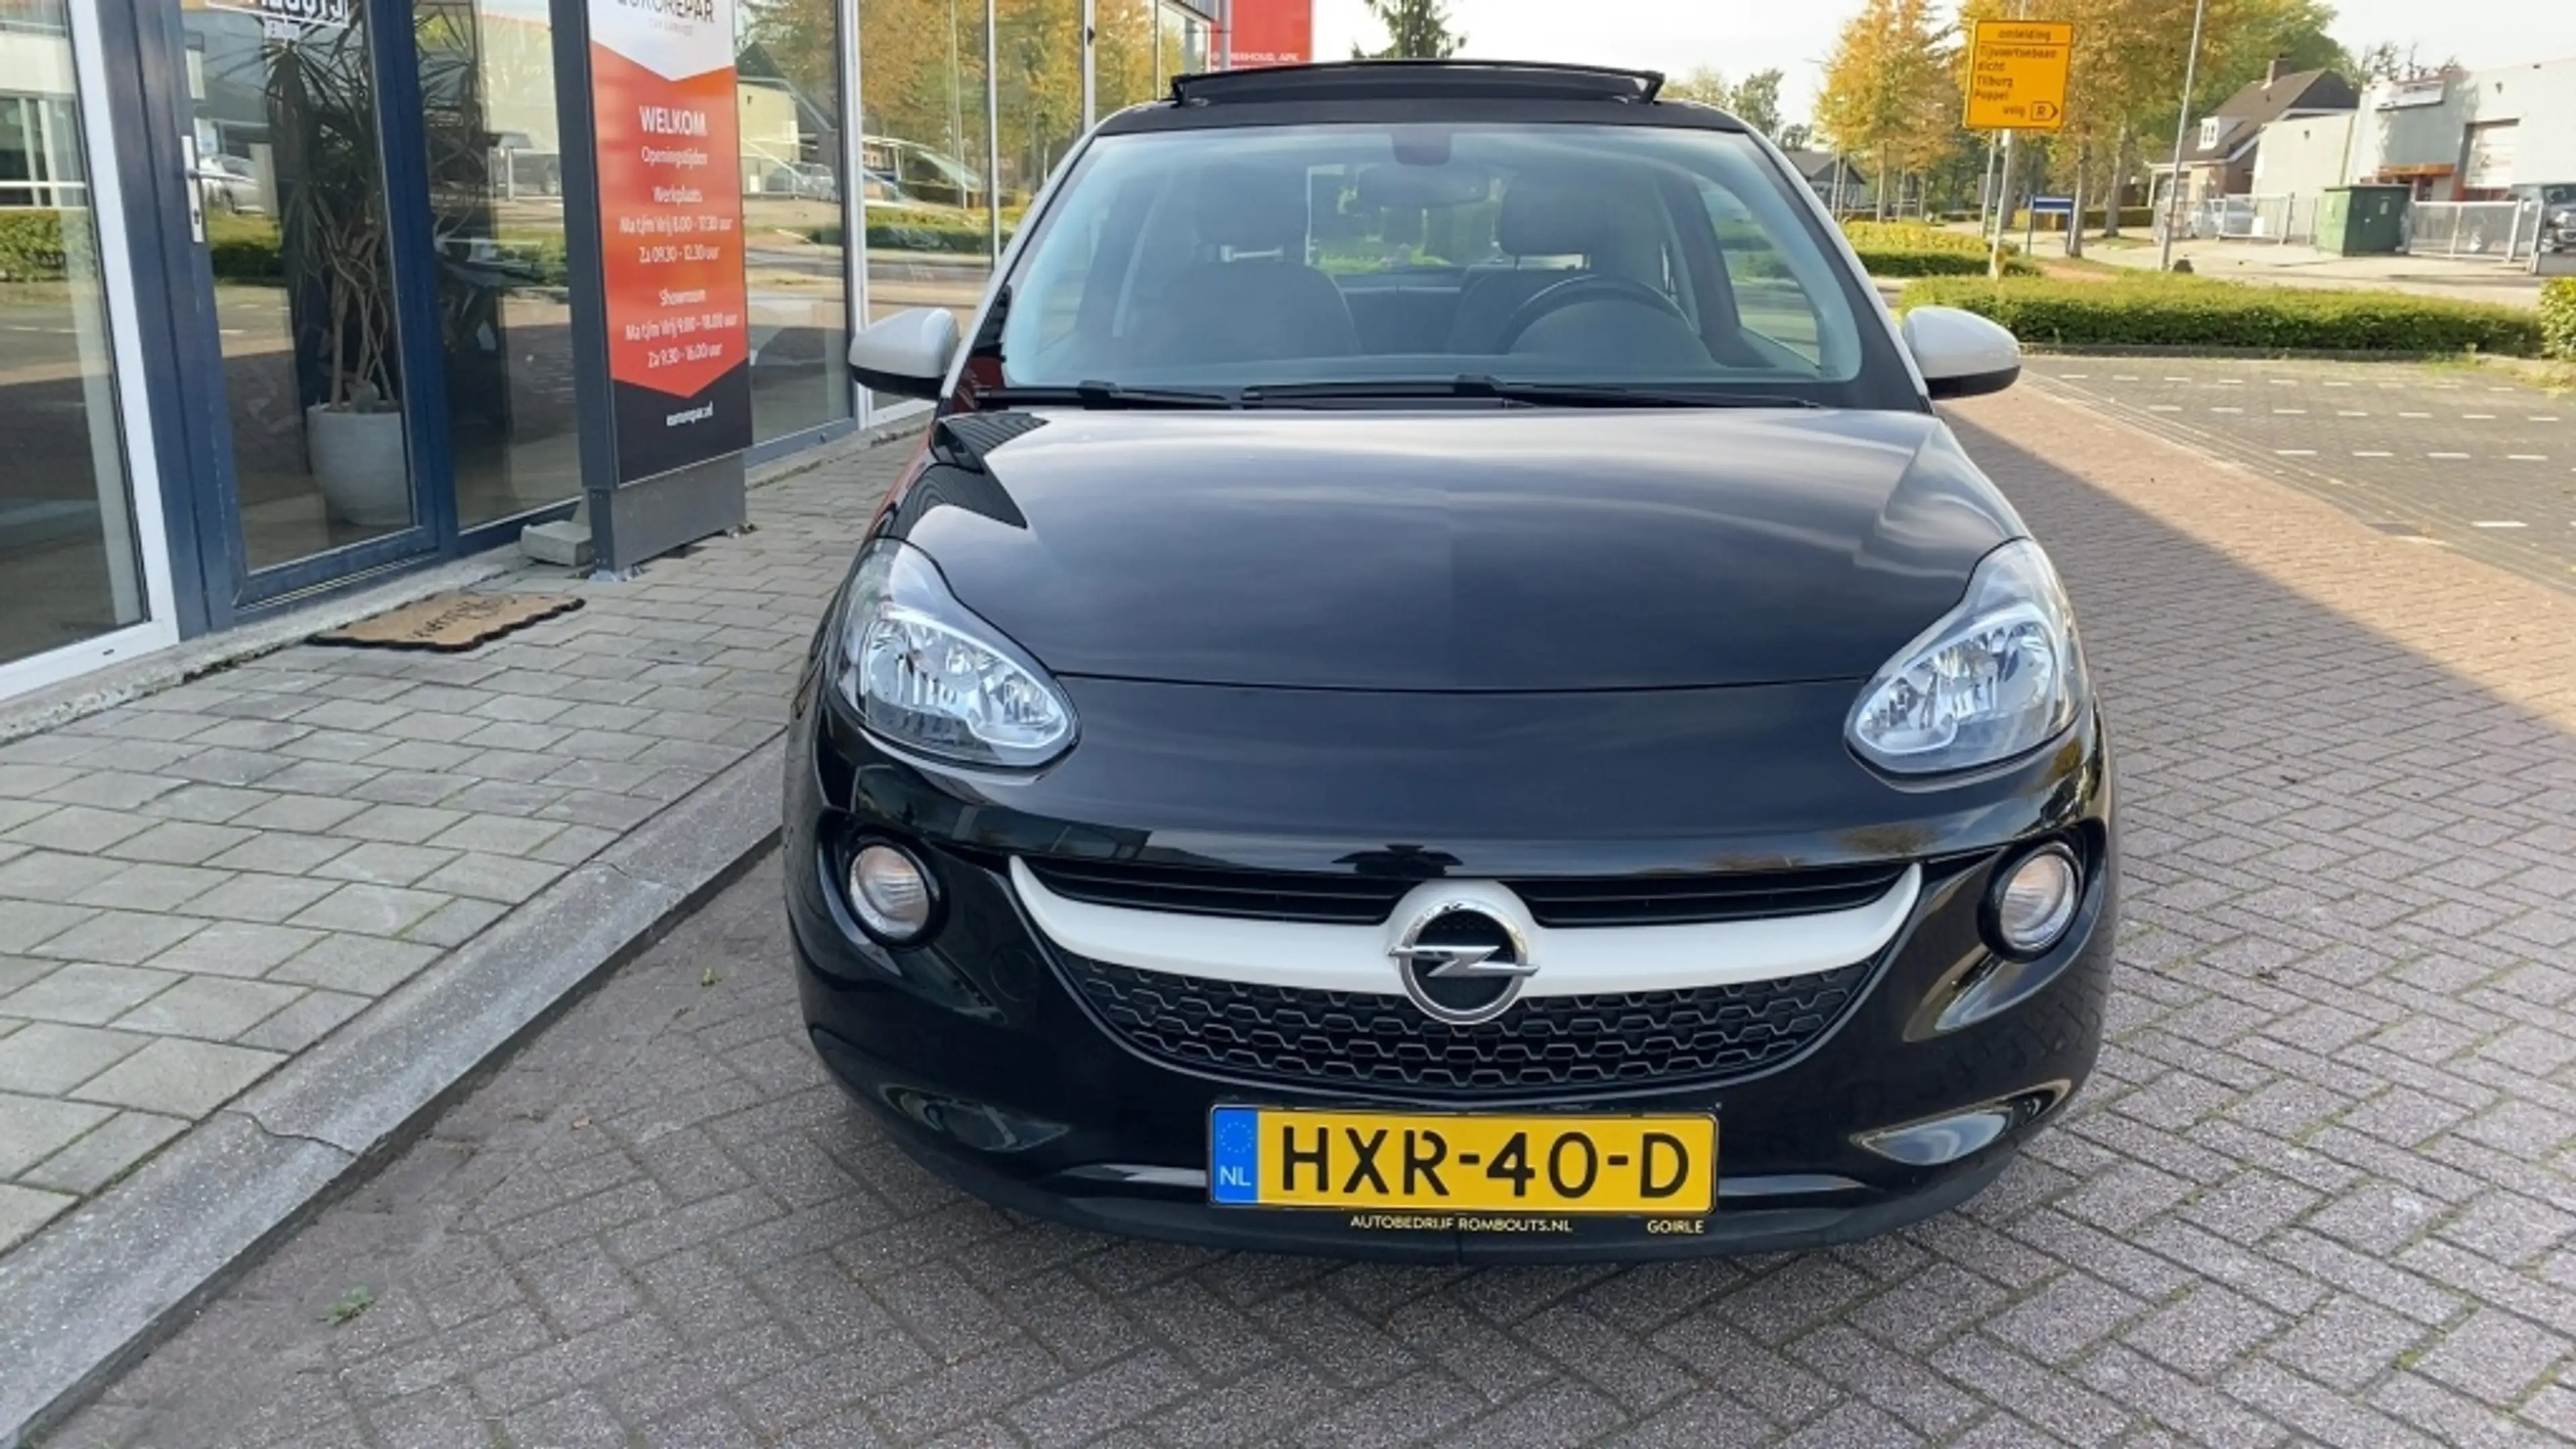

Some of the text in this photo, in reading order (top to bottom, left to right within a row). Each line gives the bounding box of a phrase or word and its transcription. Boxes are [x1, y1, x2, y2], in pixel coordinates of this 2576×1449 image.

[1978, 74, 2013, 89] Tilburg
[639, 105, 708, 137] WELKOM
[620, 216, 635, 234] Ma
[639, 246, 651, 263] Za
[625, 323, 641, 341] Ma
[647, 351, 660, 368] Za
[1220, 1126, 1690, 1199] NL HXR-40-D
[1350, 1214, 1705, 1234] AUTOBEDRIJF ROMBOUTS.NL GOIRLE
